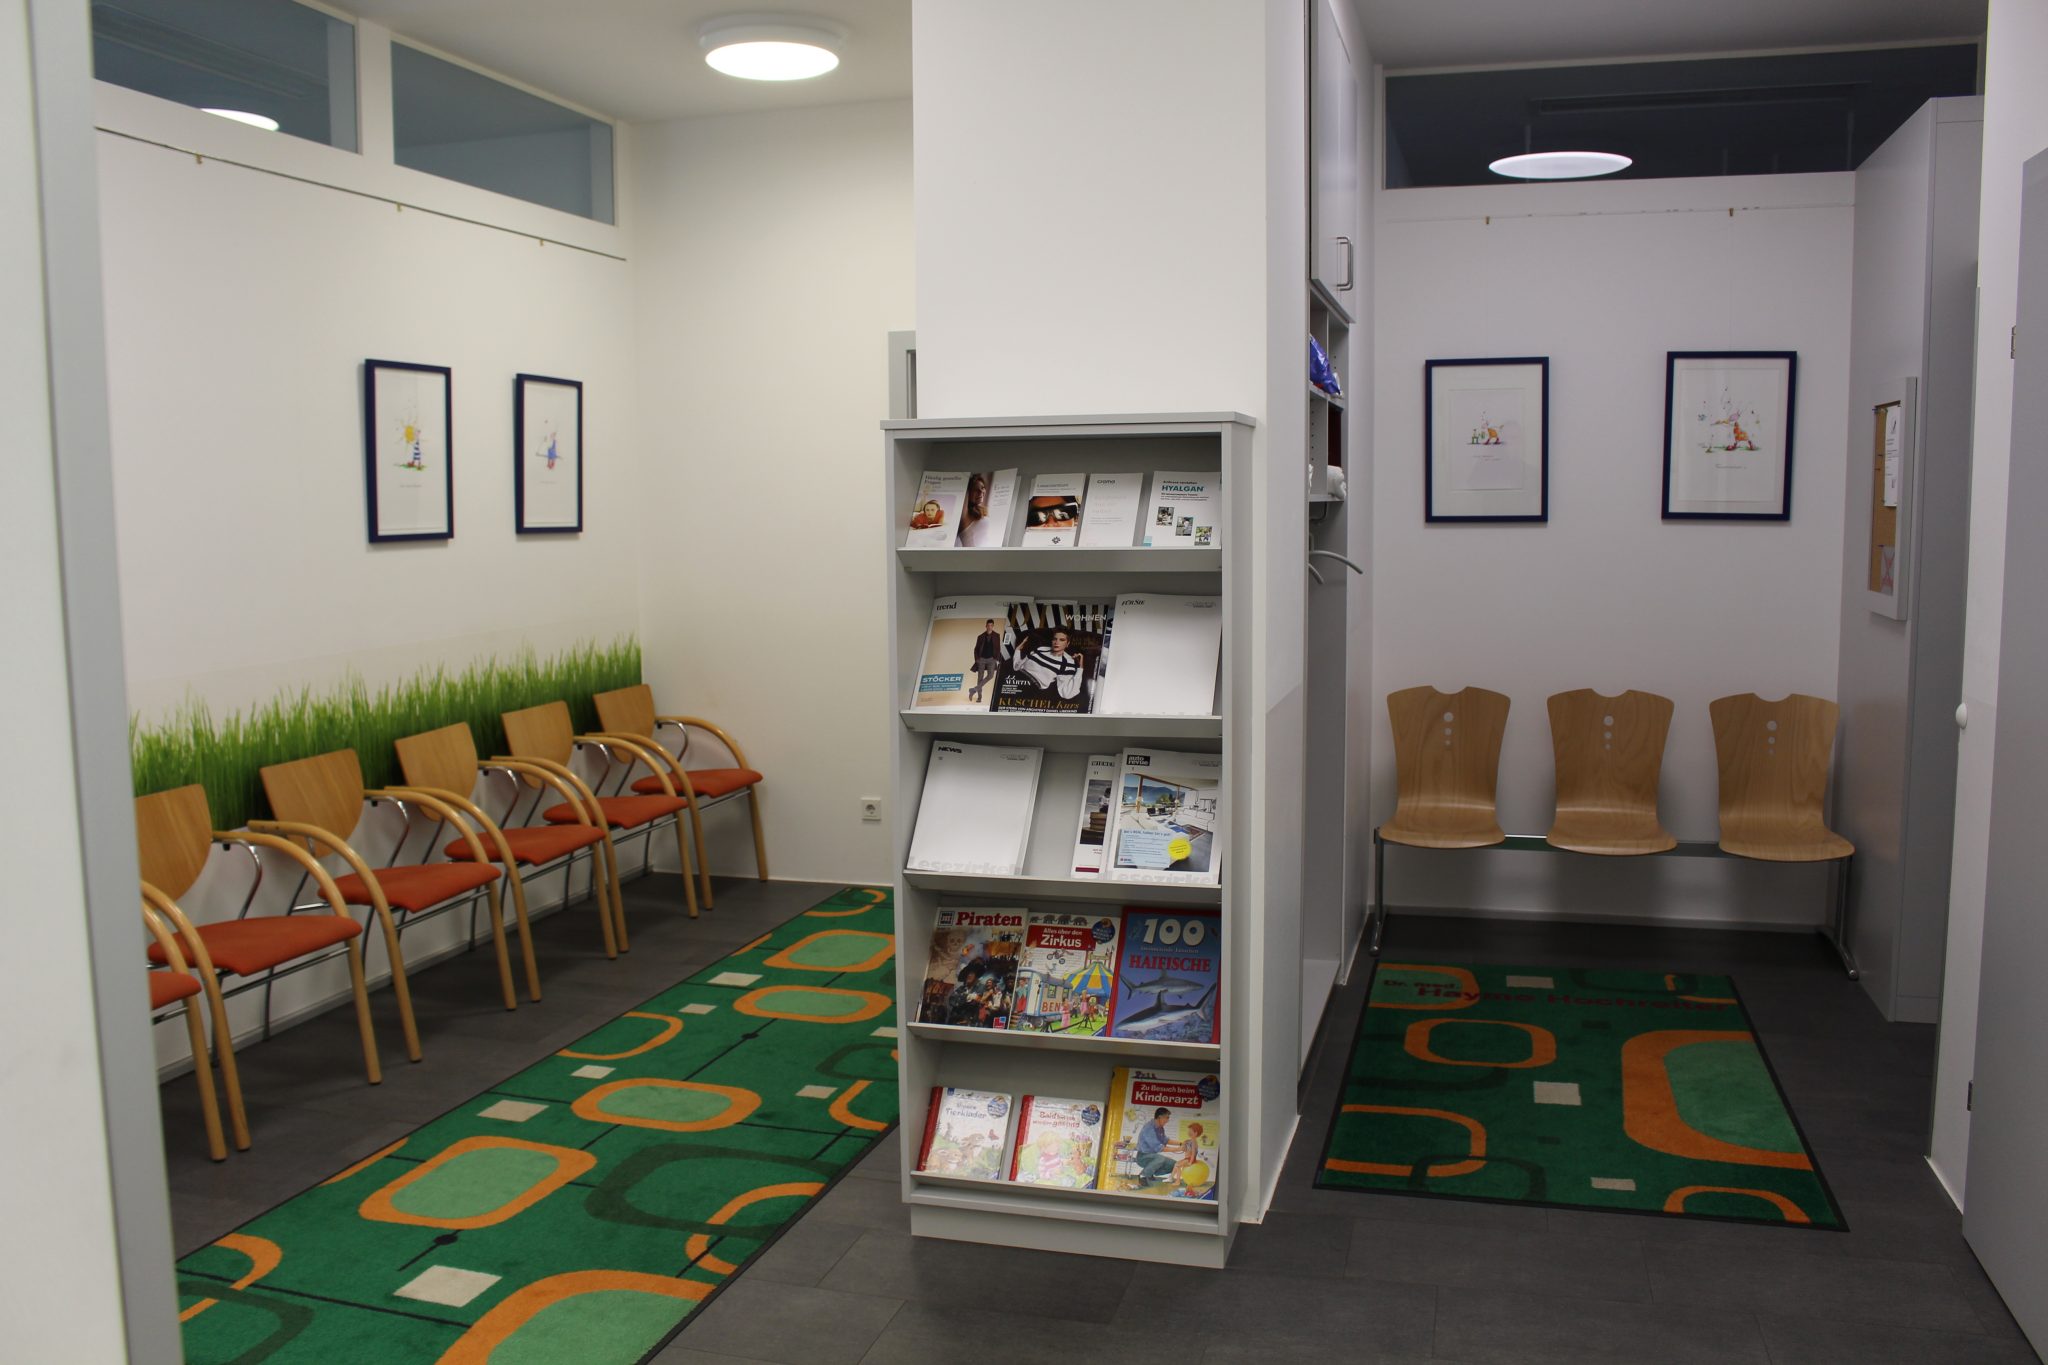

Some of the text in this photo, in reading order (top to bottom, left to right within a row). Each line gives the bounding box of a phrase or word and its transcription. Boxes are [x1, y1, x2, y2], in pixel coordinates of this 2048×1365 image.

[936, 602, 957, 611] trend
[1065, 614, 1107, 622] WOHNEN
[937, 746, 962, 754] NEWS
[955, 911, 1023, 926] Piraten
[1143, 918, 1205, 946] 100
[1040, 934, 1082, 948] Zirkus
[1129, 953, 1211, 973] HAIFISCHE
[1383, 979, 1408, 987] Dr.
[1418, 988, 1537, 1002] Haymo
[1150, 1085, 1176, 1093] Besuch
[1135, 1091, 1199, 1105] Kinderarzt
